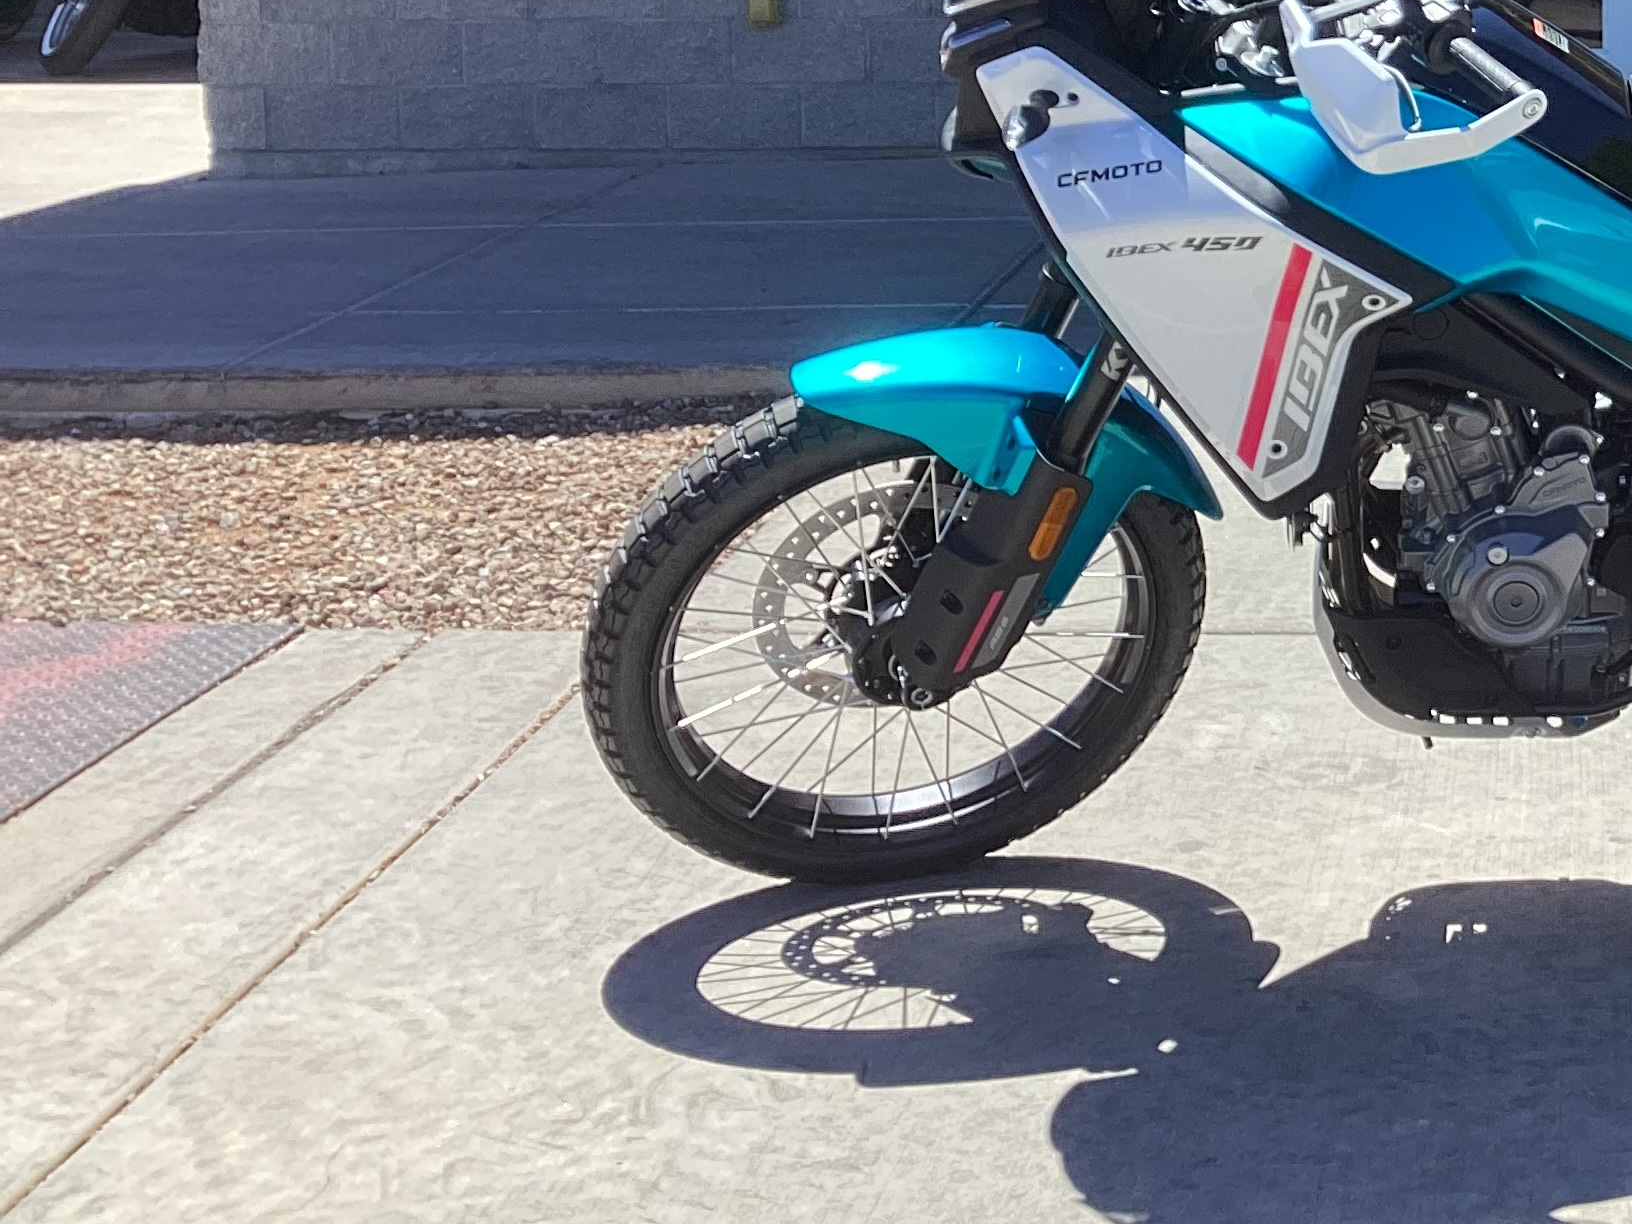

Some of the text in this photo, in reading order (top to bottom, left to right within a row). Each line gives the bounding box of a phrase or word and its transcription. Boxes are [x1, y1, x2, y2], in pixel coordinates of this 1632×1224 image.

[1057, 159, 1163, 188] CFMOTO
[1106, 235, 1264, 258] IBEX 450
[1283, 266, 1349, 432] IBEX
